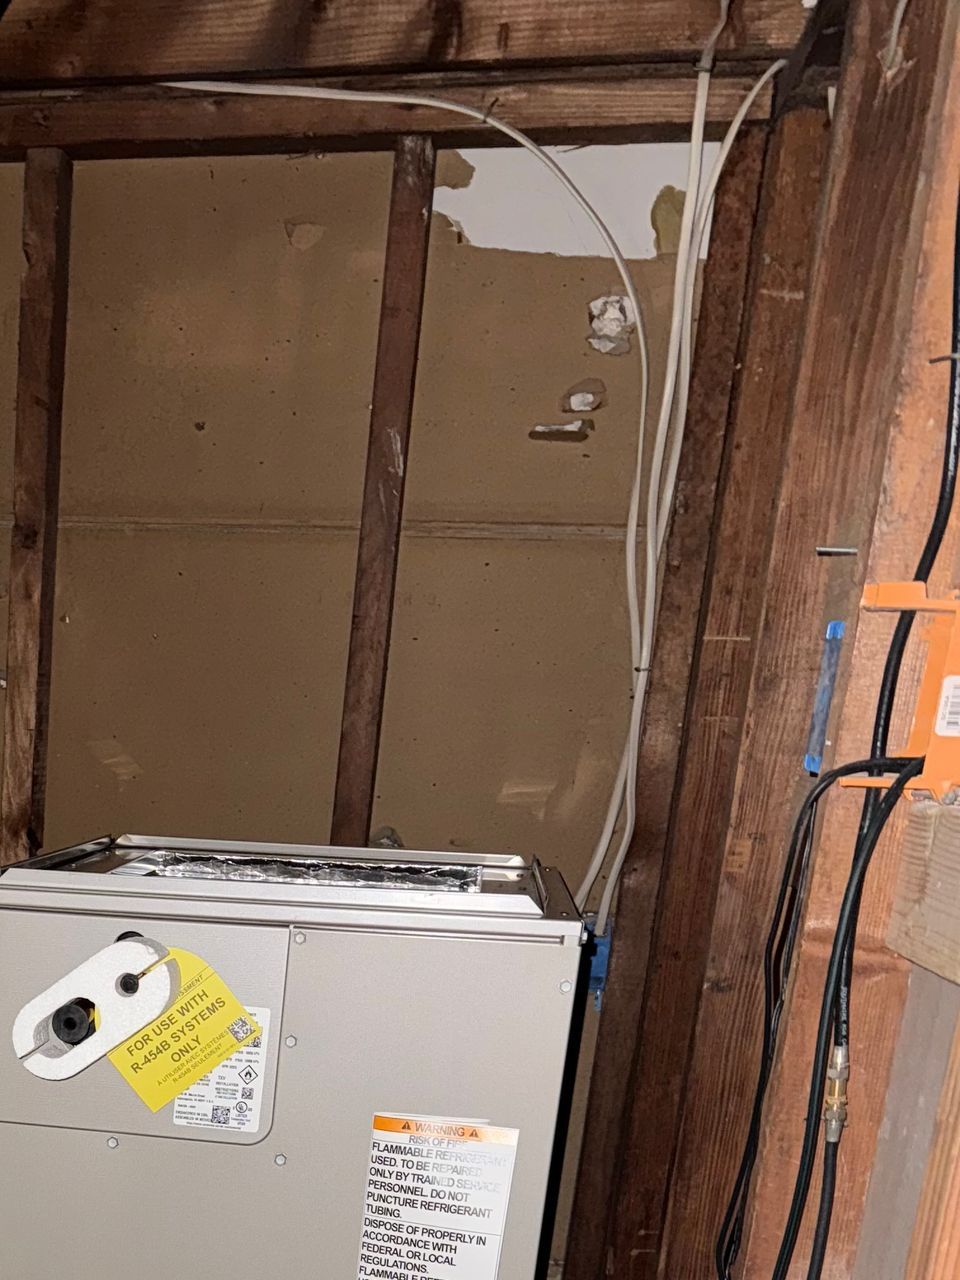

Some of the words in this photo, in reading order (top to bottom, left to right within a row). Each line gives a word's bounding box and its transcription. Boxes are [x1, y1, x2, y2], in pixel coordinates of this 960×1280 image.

[126, 1032, 152, 1056] FOR
[152, 1014, 178, 1036] USE
[177, 990, 208, 1017] WITH
[130, 1040, 171, 1074] R-454B
[172, 997, 226, 1043] SYSTEMS
[171, 1034, 202, 1063] ONLY
[185, 1051, 201, 1068] AVEC
[190, 1044, 222, 1070] SEULEMENT
[408, 1135, 431, 1145] RISK
[432, 1137, 446, 1146] OF
[415, 1122, 465, 1136] WARNING
[372, 1142, 433, 1158] FLAMMABLE
[371, 1154, 398, 1167] USED.
[401, 1158, 414, 1169] TO
[416, 1160, 430, 1171] BE
[368, 1179, 428, 1197] PERSONNEL.
[430, 1188, 446, 1199] DO
[448, 1190, 470, 1202] NOT
[369, 1167, 395, 1180] ONLY
[395, 1170, 409, 1182] BY
[411, 1173, 454, 1188] TRAINED
[456, 1179, 500, 1193] SERVICE
[366, 1204, 402, 1218] TUBING.
[367, 1192, 418, 1208] PUNCTURE
[420, 1200, 492, 1218] REFRIGERANT
[362, 1230, 430, 1250] ACCORDANCE
[432, 1241, 457, 1254] WITH
[364, 1218, 404, 1233] DISPOSE
[406, 1225, 420, 1235] OF
[422, 1227, 476, 1244] PROPERLY
[476, 1235, 486, 1246] IN
[360, 1254, 429, 1274] REGULATIONS.
[361, 1242, 404, 1258] FEDERAL
[406, 1250, 421, 1261] OR
[422, 1252, 456, 1266] LOCAL
